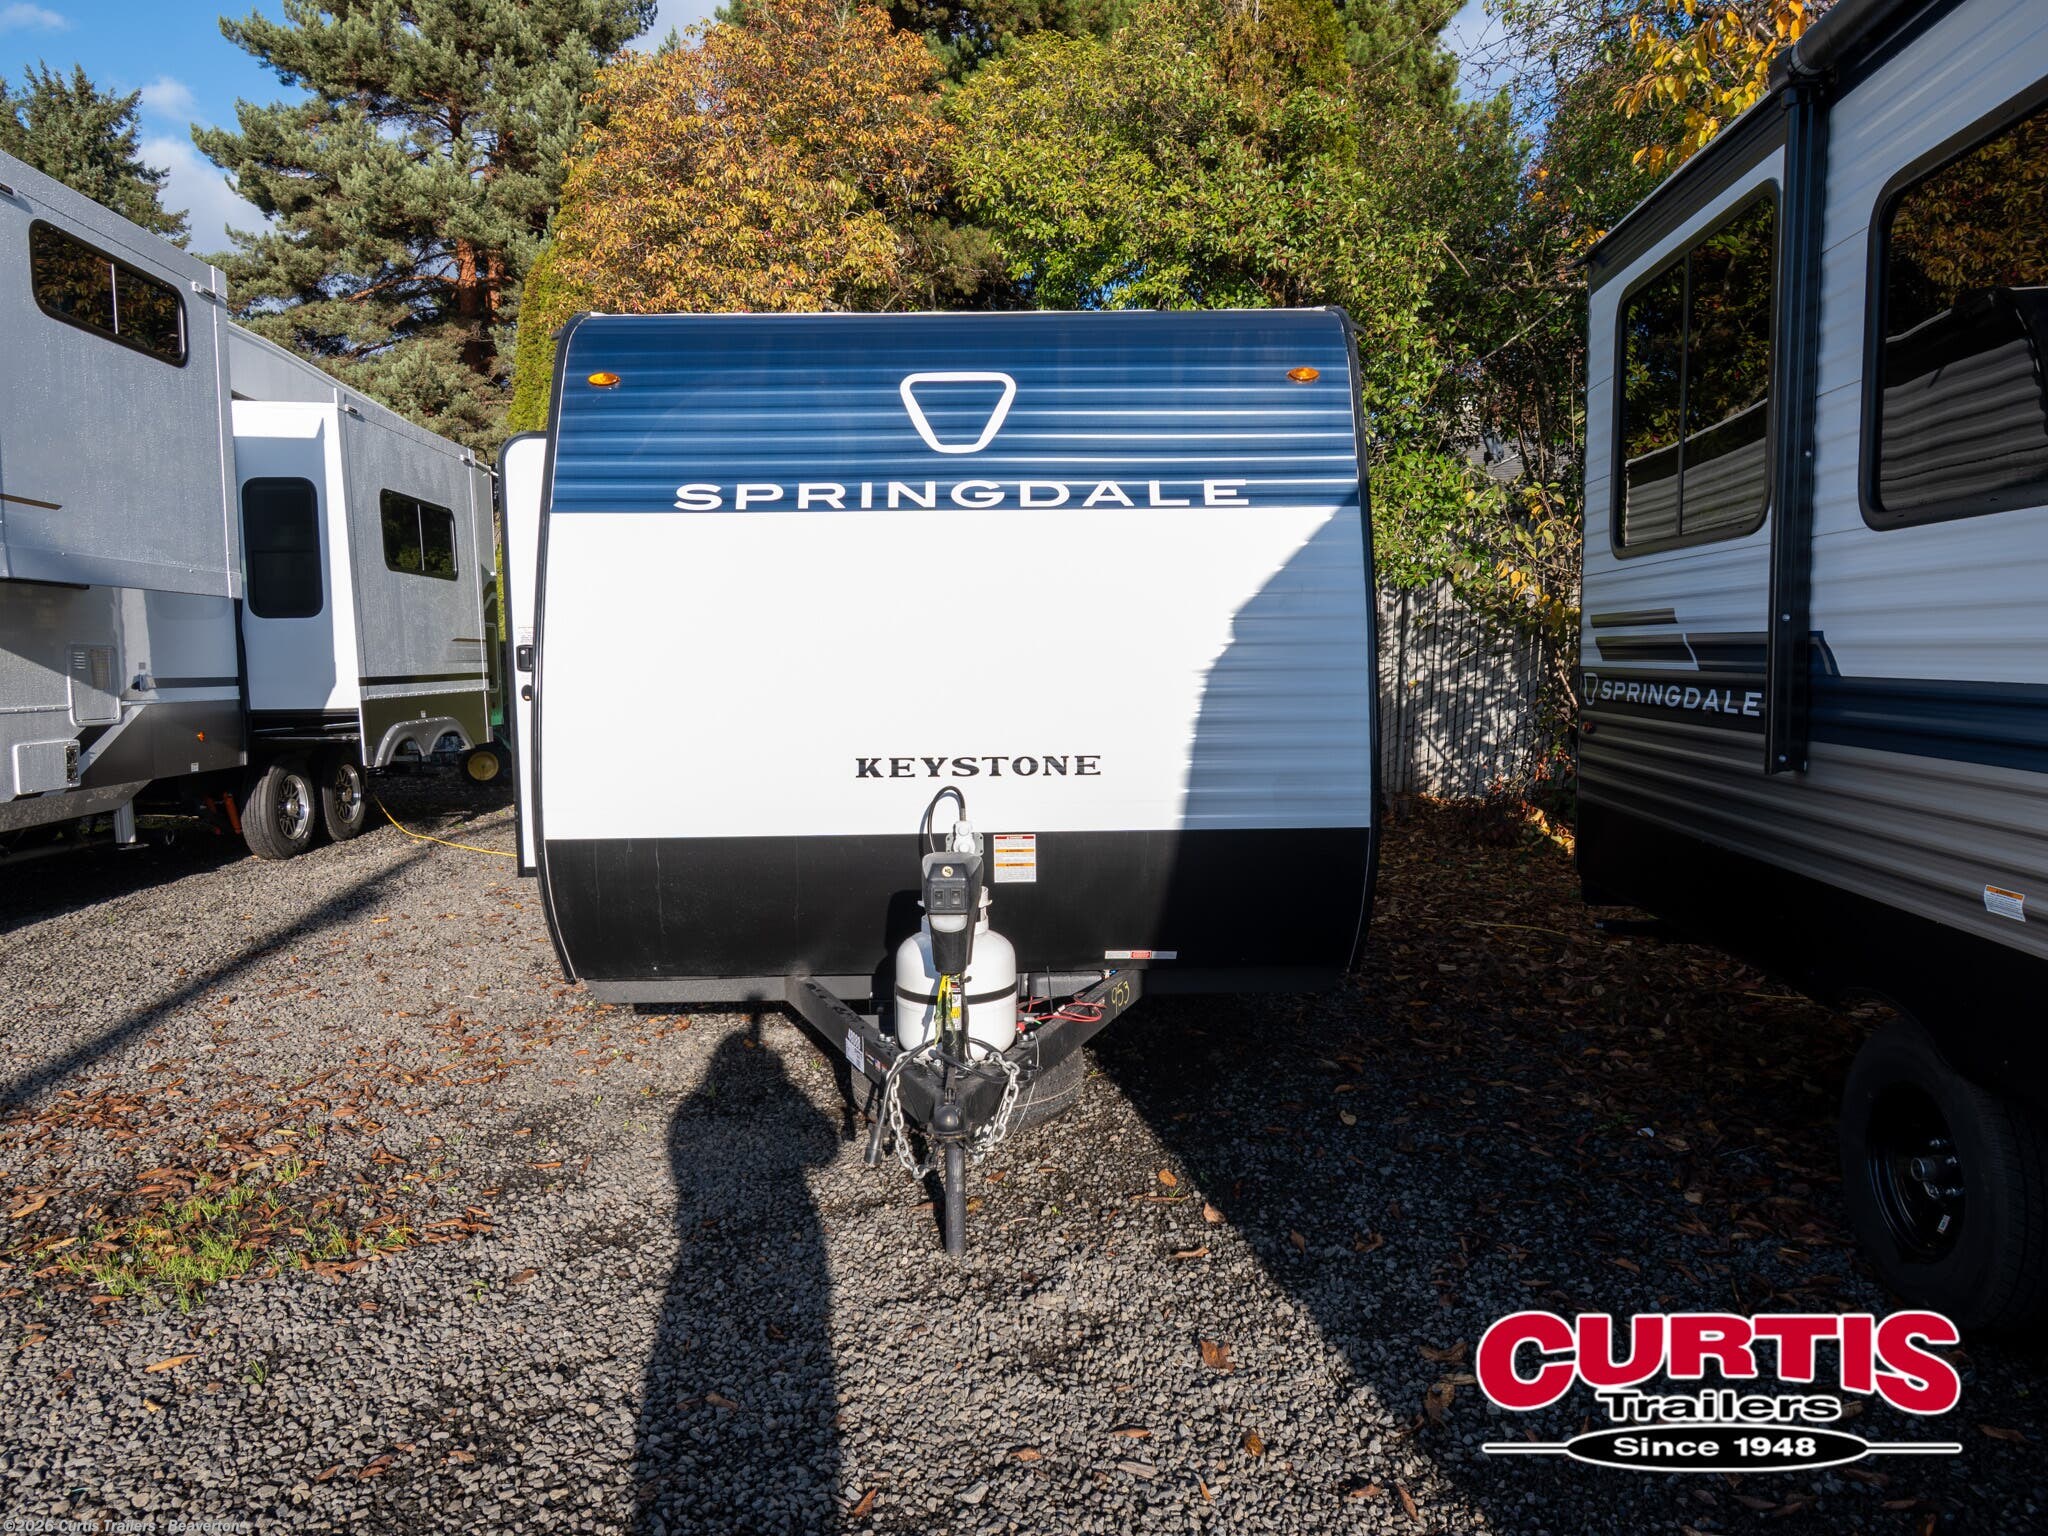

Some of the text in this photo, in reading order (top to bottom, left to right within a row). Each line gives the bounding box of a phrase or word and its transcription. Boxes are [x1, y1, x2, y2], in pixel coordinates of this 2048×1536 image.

[673, 478, 1251, 512] SPRINGDALE
[1600, 680, 1763, 717] SPRINGDALE
[855, 755, 1102, 778] KEYSTONE
